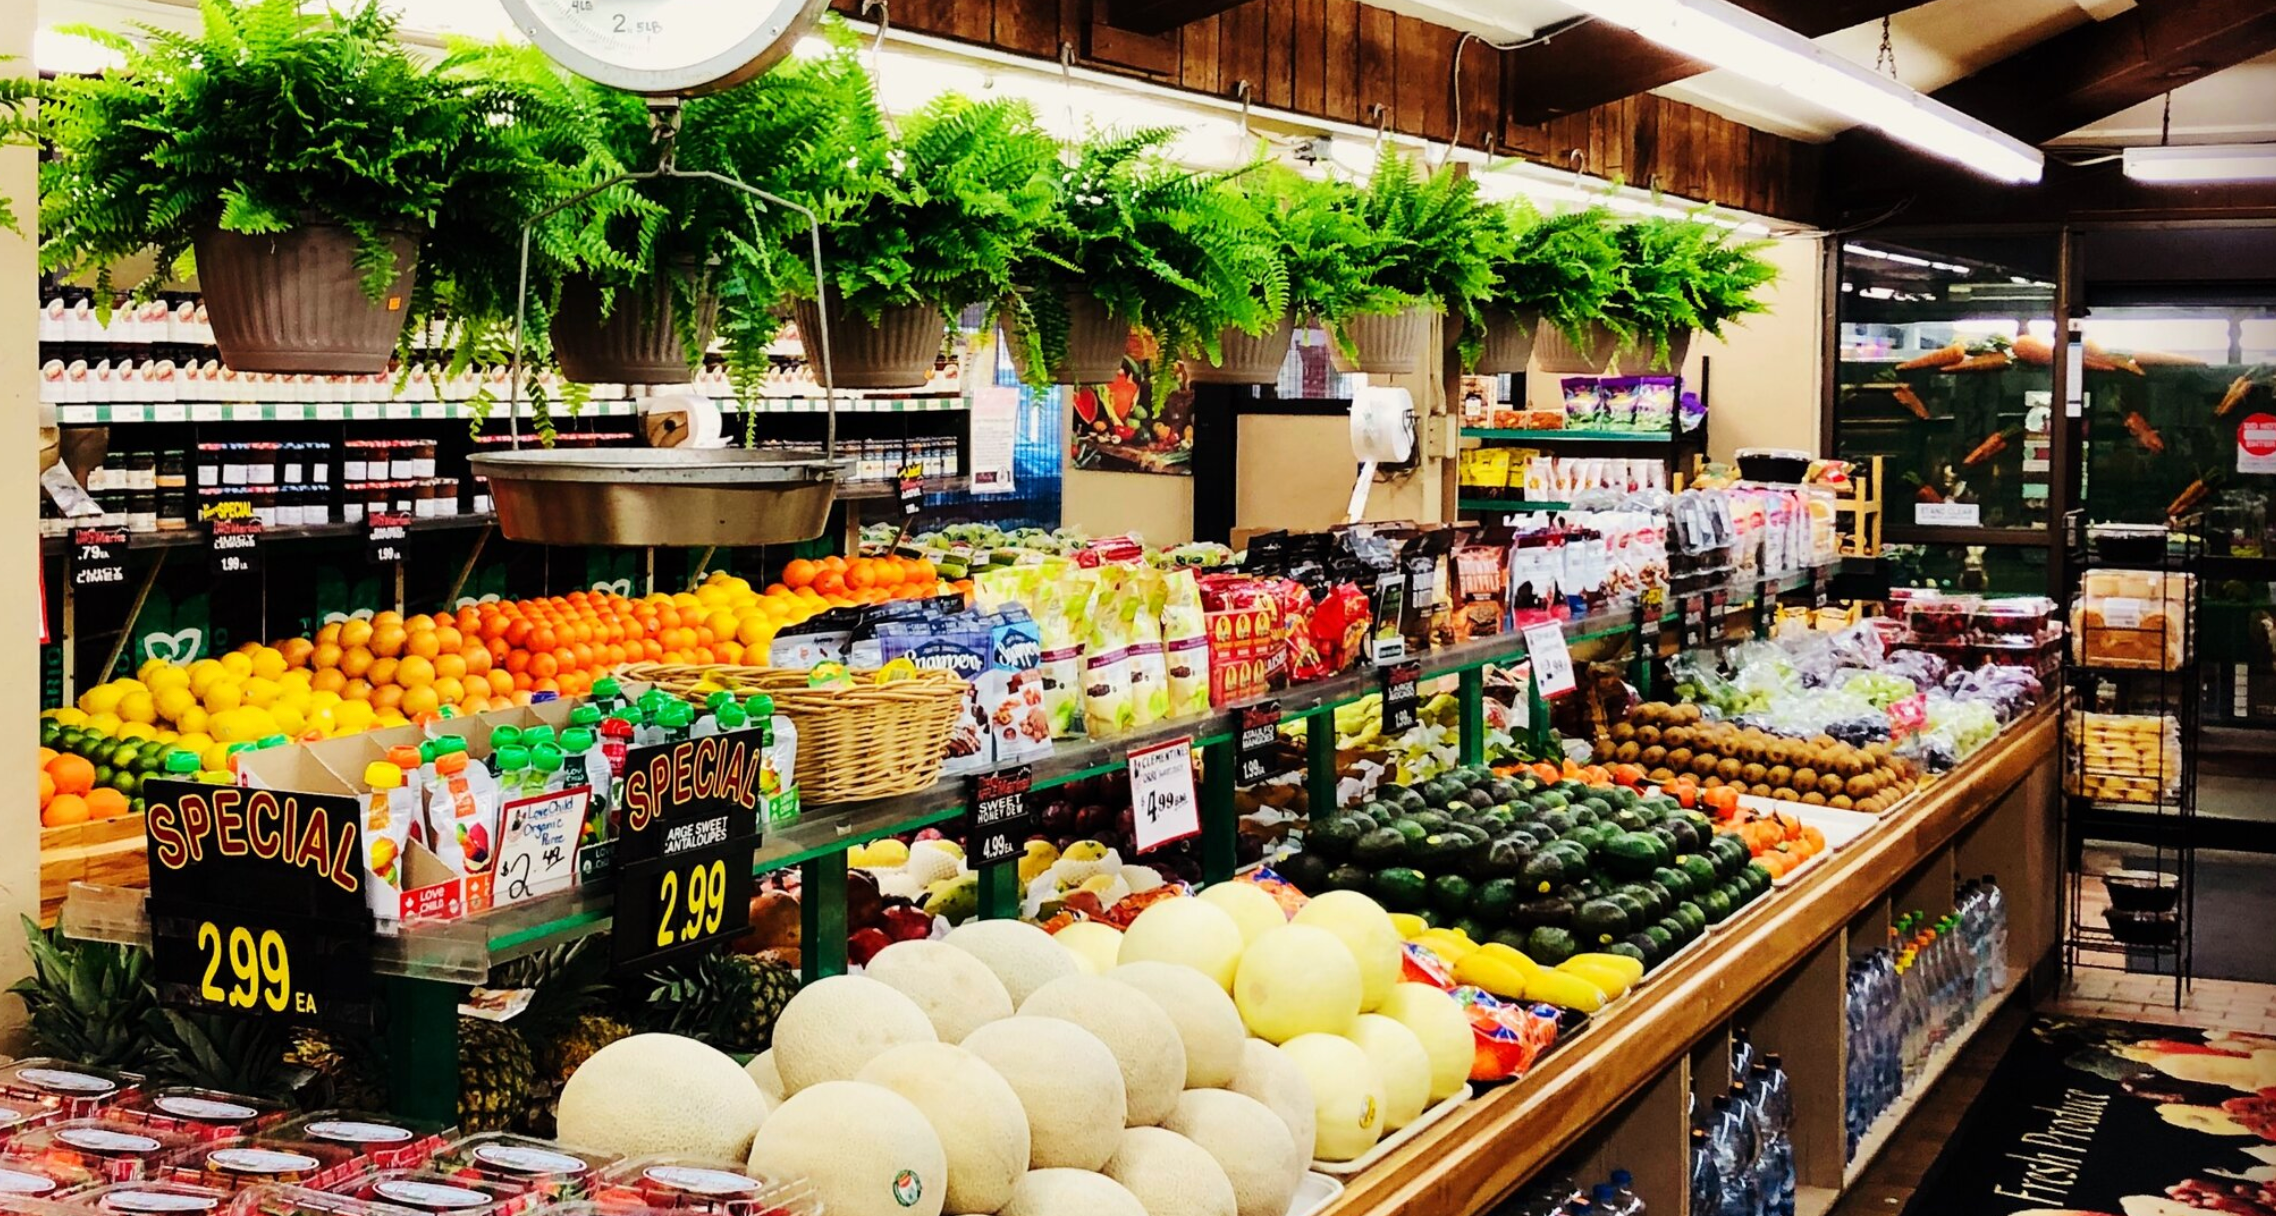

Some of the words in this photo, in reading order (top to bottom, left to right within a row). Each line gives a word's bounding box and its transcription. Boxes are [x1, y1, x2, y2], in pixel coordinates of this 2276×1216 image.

[221, 556, 240, 571] 1.99
[626, 737, 760, 831] SPECIAL
[978, 793, 1023, 814] SWEET
[667, 825, 694, 841] ARGE
[695, 816, 729, 834] SWEET
[977, 806, 1004, 824] HONEY
[148, 789, 358, 892] SPECIAL
[983, 834, 1006, 859] 4.99
[420, 886, 445, 902] LOVE
[657, 860, 726, 947] 2.99
[198, 921, 290, 1012] 2.99
[295, 992, 317, 1014] EA
[2021, 1088, 2111, 1152] Produce
[1994, 1152, 2082, 1206] Fresh
